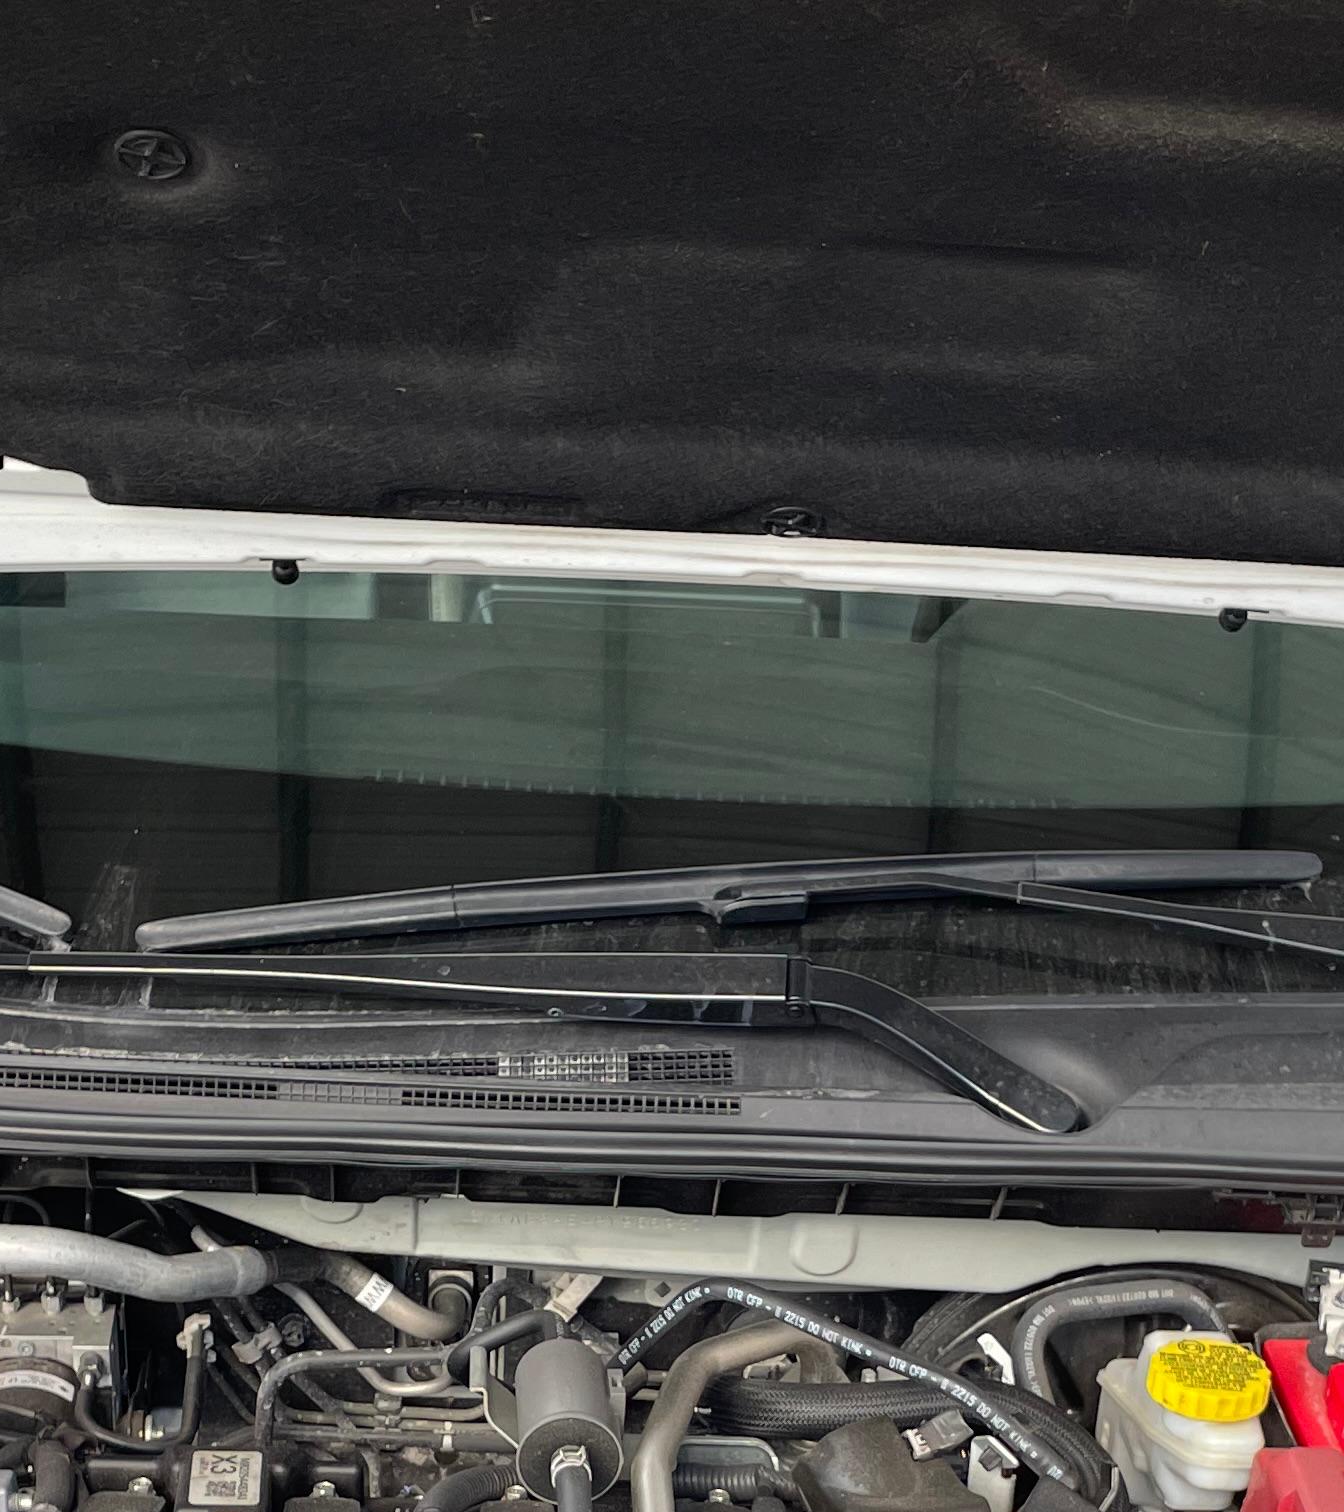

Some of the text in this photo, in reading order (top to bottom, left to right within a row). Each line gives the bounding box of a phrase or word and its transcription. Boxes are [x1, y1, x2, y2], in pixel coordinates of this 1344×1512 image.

[808, 1321, 820, 1335] DO
[821, 1327, 838, 1343] NOT
[976, 1398, 991, 1418] DO
[990, 1413, 1010, 1432] NOT
[210, 1454, 238, 1474] X3
